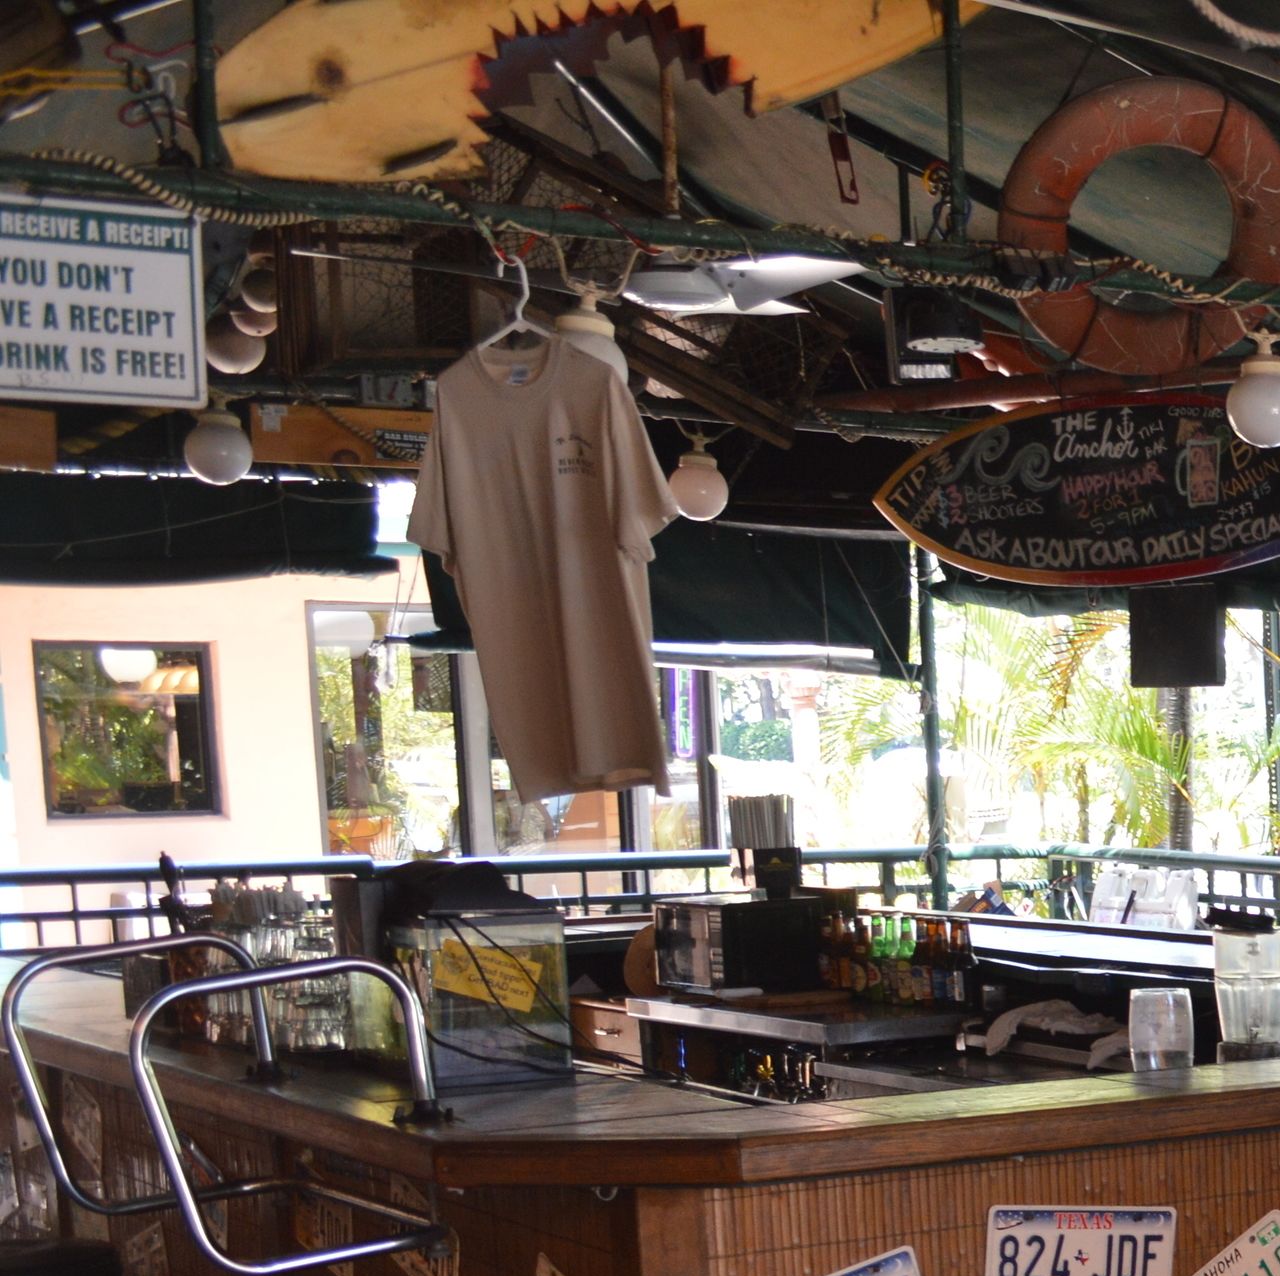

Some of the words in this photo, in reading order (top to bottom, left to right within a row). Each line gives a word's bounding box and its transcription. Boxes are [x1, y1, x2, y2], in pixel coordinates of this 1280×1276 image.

[1, 212, 81, 240] RECEIVE
[86, 219, 100, 241] A
[105, 222, 189, 249] RECEIPT!
[58, 262, 134, 294] DON'T
[43, 303, 58, 330] A
[69, 304, 175, 338] RECEIPT
[0, 342, 70, 373] RINK
[81, 346, 107, 375] IS
[116, 349, 186, 380] FREE!
[1052, 410, 1097, 436] THE
[963, 484, 1018, 504] BEER
[1093, 492, 1128, 514] FOR
[969, 498, 1044, 524] SHOOTERS
[953, 526, 1008, 562] ASK
[1008, 534, 1091, 570] ABOUT
[1089, 535, 1143, 567] OUR
[1141, 526, 1206, 566] DAILY
[1055, 1212, 1114, 1230] TEXAS
